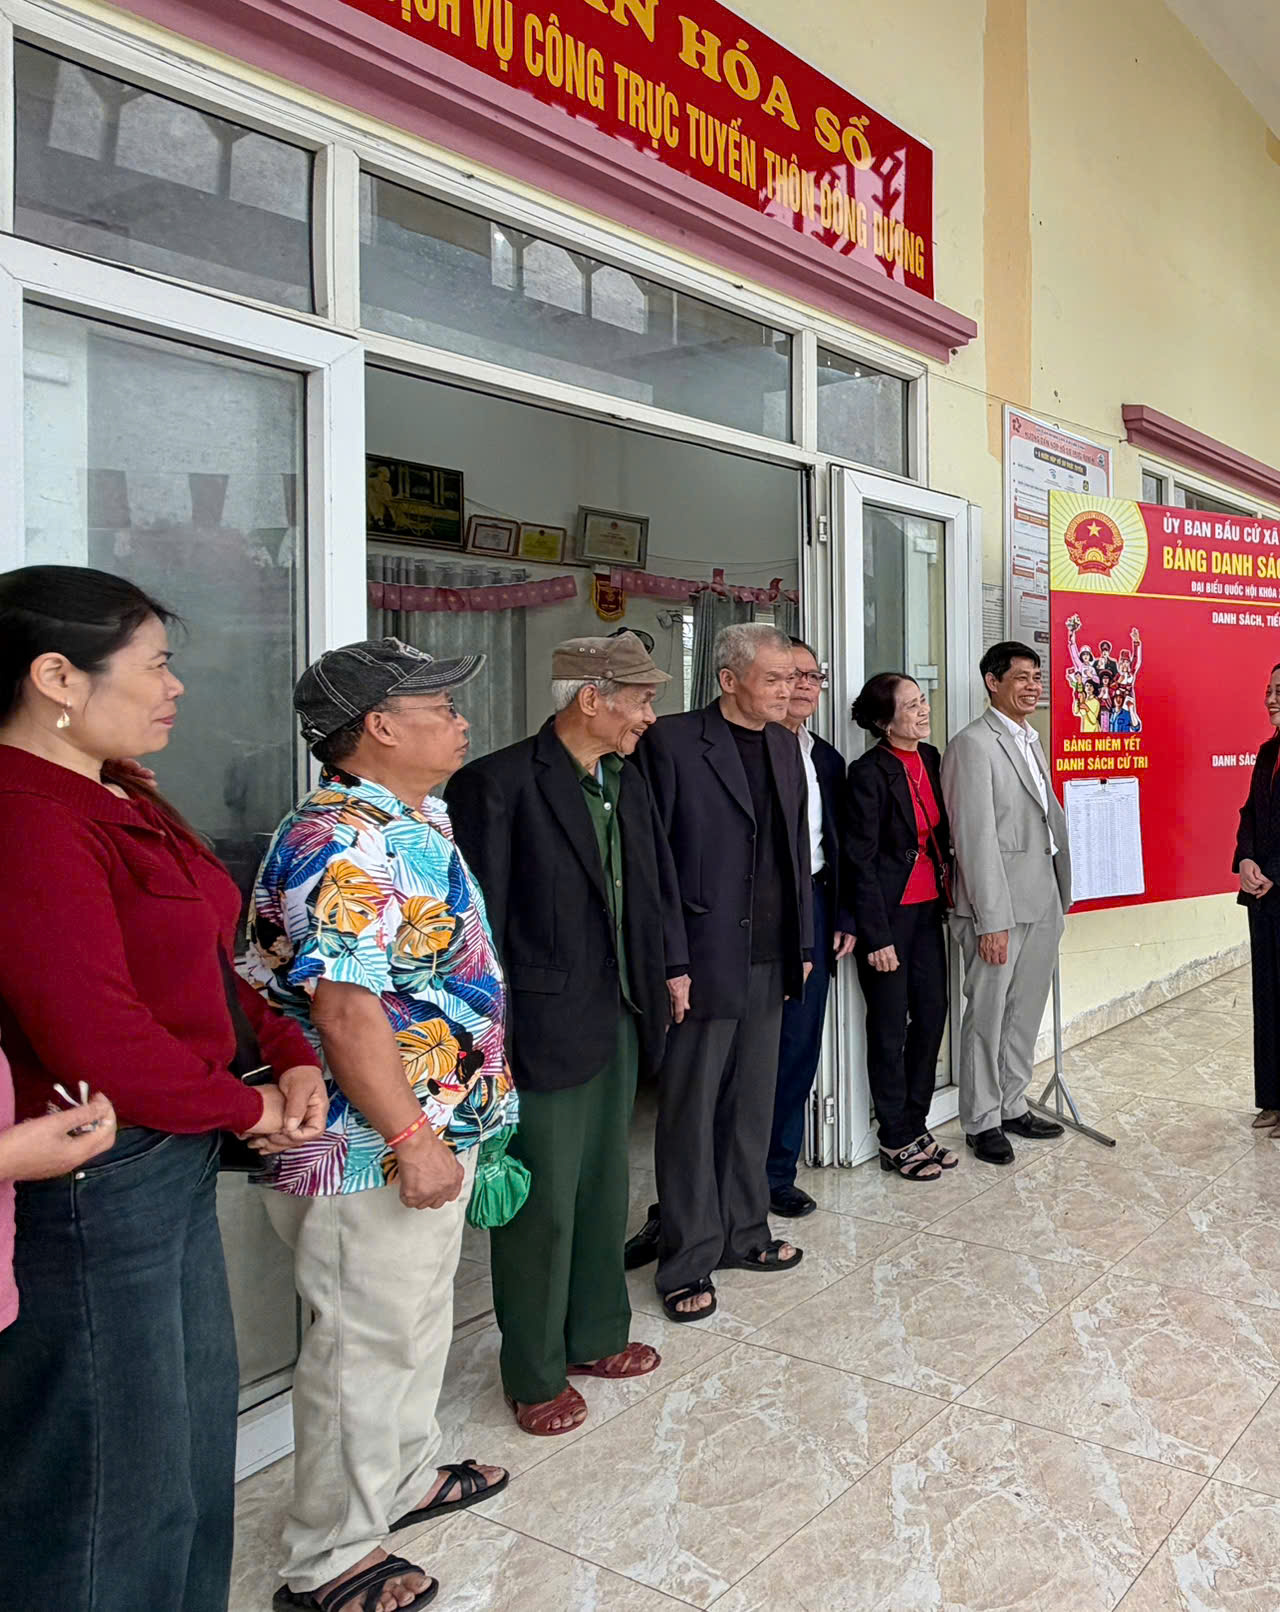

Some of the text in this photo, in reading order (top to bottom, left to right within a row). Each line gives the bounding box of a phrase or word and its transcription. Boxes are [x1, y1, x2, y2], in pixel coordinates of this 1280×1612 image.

[678, 15, 800, 131] HÓA
[814, 107, 873, 171] SỐ
[473, 0, 513, 72] VỤ
[524, 13, 605, 111] CÔNG
[613, 61, 680, 150] TRỰC
[686, 102, 757, 190] TUYẾN
[763, 147, 816, 222] THÔN
[1163, 512, 1180, 534] ỦY
[1184, 520, 1211, 538] BAN
[1243, 523, 1262, 544] CỬ
[1263, 527, 1279, 546] XÃ
[1163, 540, 1207, 573] BẢNG
[1211, 551, 1253, 577] DANH
[1191, 581, 1204, 595] ĐẠI
[1224, 581, 1244, 596] QUỐC
[1245, 584, 1257, 599] HỘI
[1258, 586, 1277, 598] KHÓA
[1212, 612, 1237, 625] DANH
[1239, 612, 1265, 628] SÁCH,
[1063, 734, 1141, 752] BẢNG NIÊM YẾT
[1056, 752, 1148, 771] DANH SÁCH CỬ TRI
[1212, 751, 1257, 767] DANH SÁC
